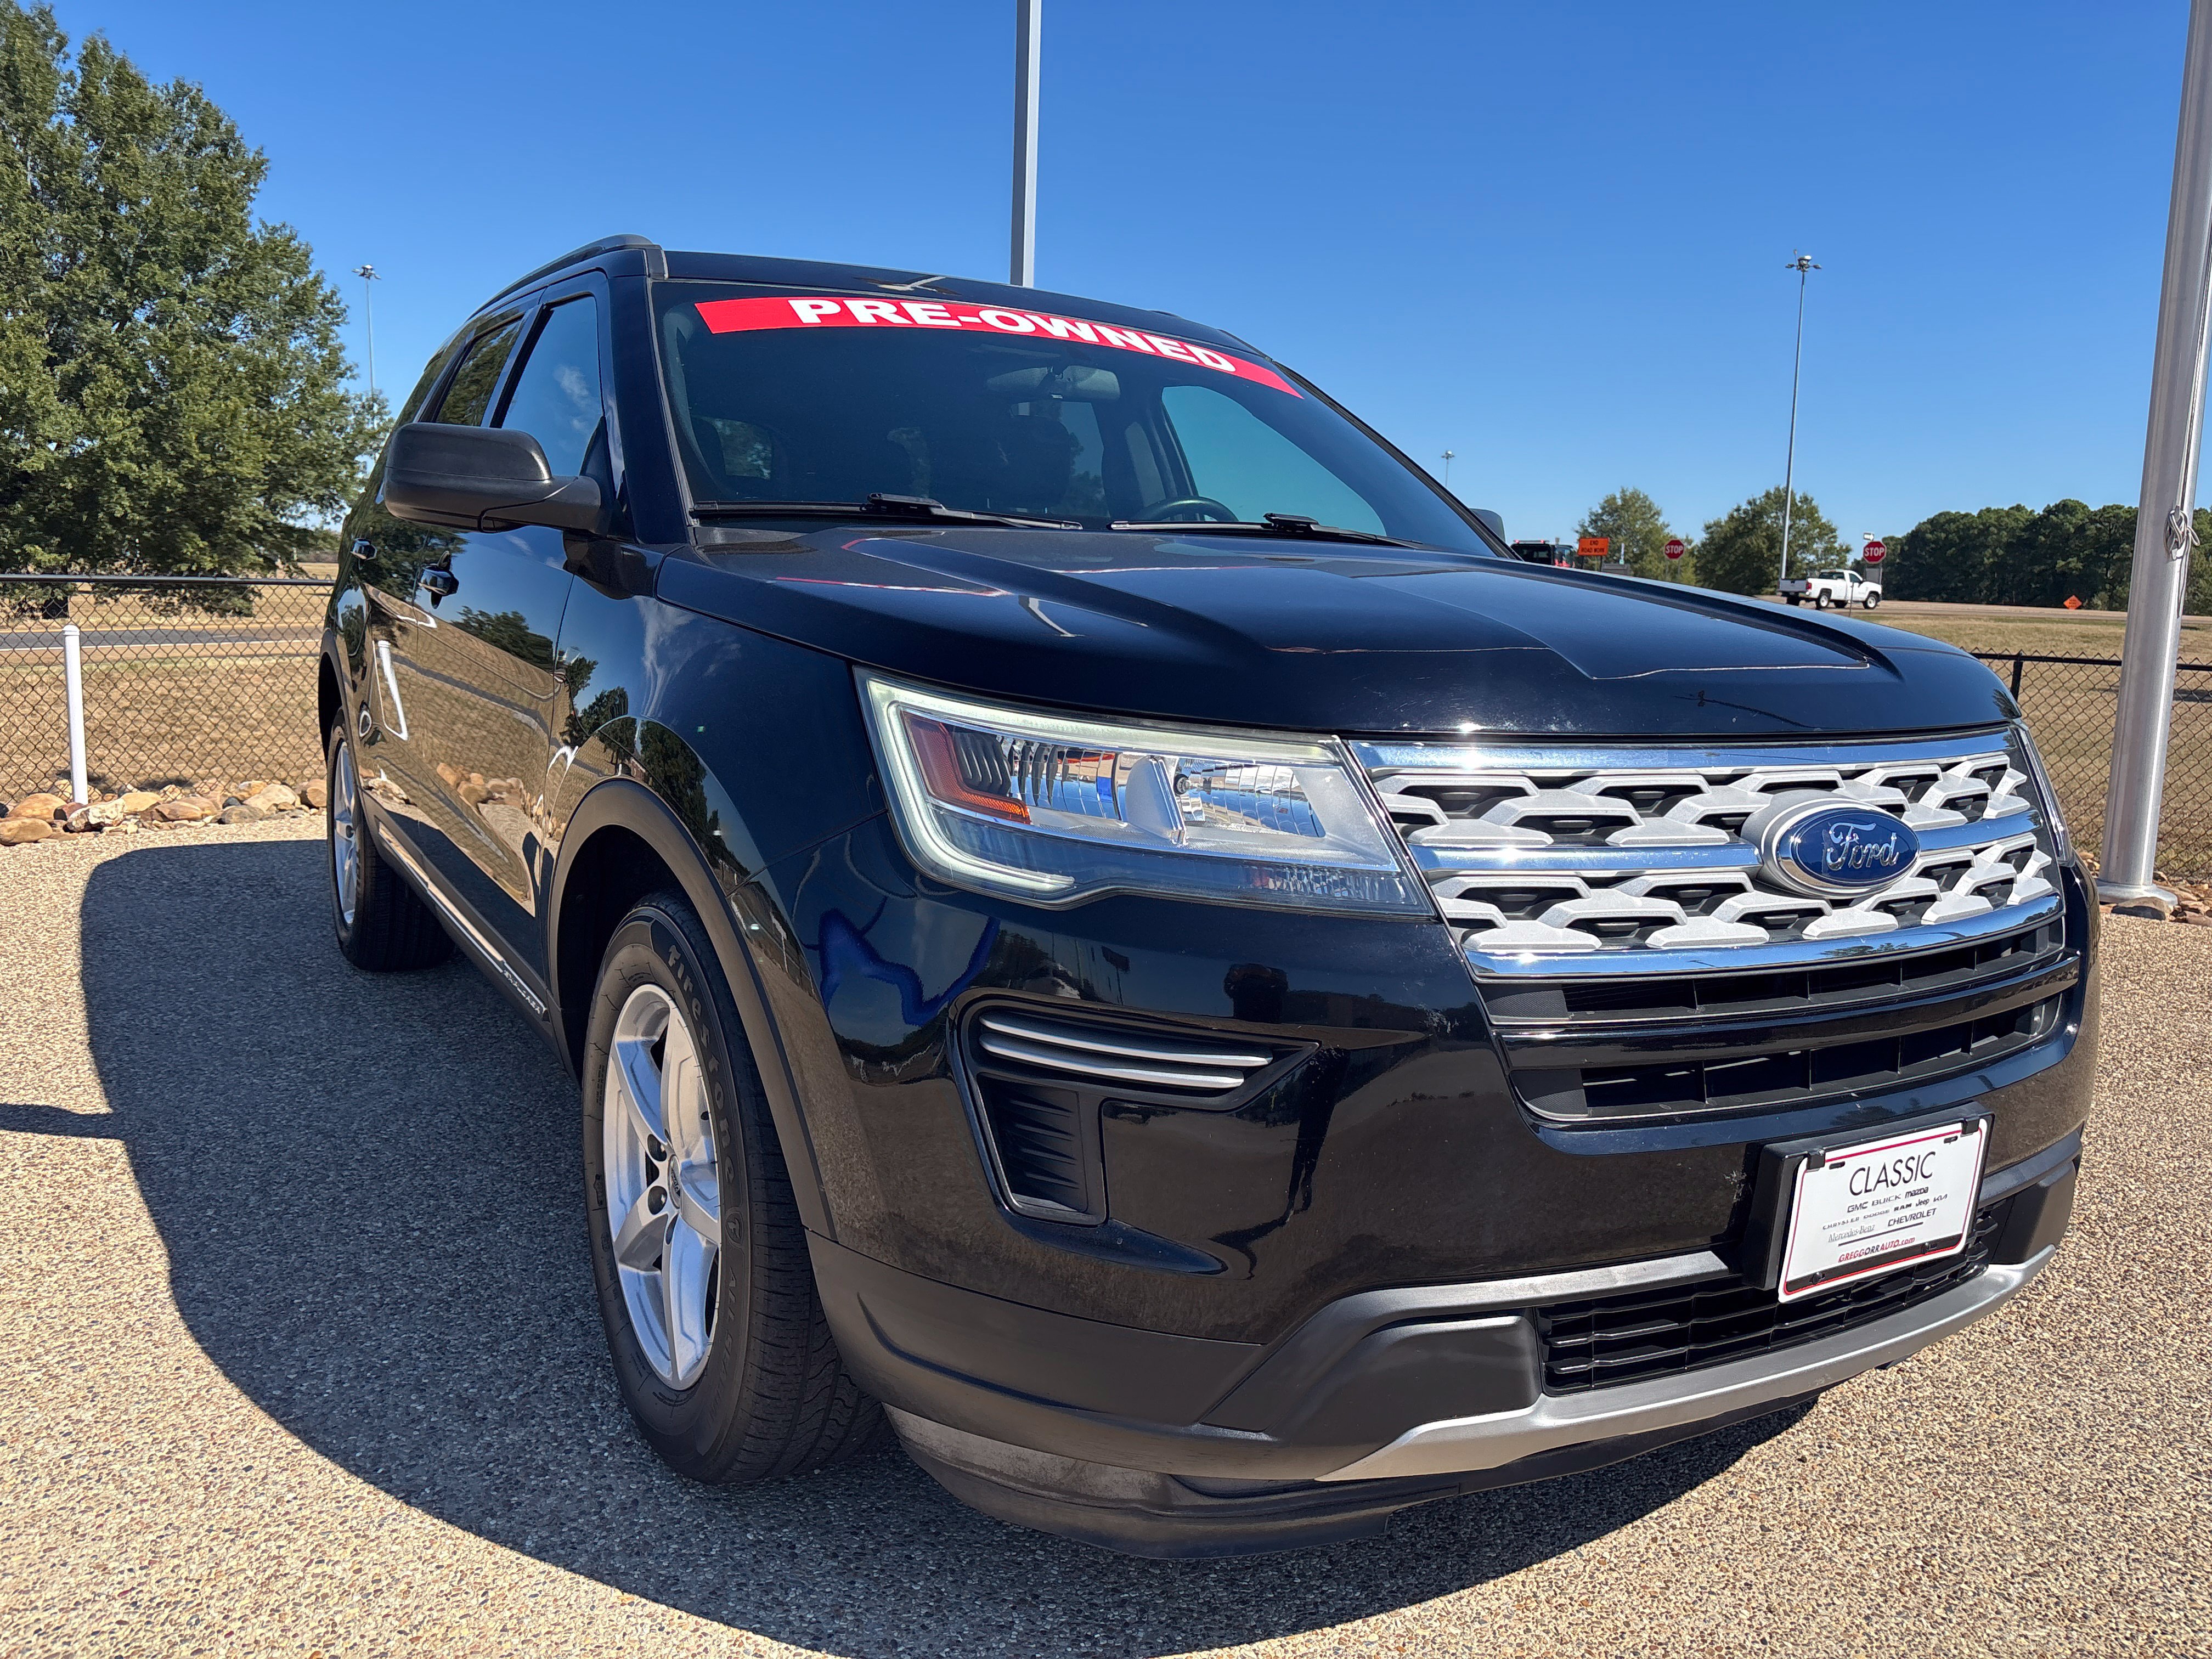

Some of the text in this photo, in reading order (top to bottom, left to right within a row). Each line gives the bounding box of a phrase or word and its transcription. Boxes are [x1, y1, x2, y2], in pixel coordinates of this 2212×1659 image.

[787, 299, 1237, 373] PRE-OWNED
[1665, 545, 1684, 554] STOP
[1864, 547, 1885, 557] STOP
[1826, 822, 1899, 871] Ford
[1849, 1151, 1936, 1196] CLASSIC
[1822, 1217, 1860, 1230] CHRYSLER
[1863, 1209, 1890, 1219] DODGE
[1894, 1203, 1912, 1212] RAM
[1915, 1198, 1930, 1207] Jeep
[1847, 1201, 1869, 1213] GMC
[1871, 1194, 1901, 1206] BUICK
[1828, 1207, 1937, 1243] Mercedes-Benz CHEVROLET
[1838, 1237, 1916, 1262] GREGGORRAUTO.com
